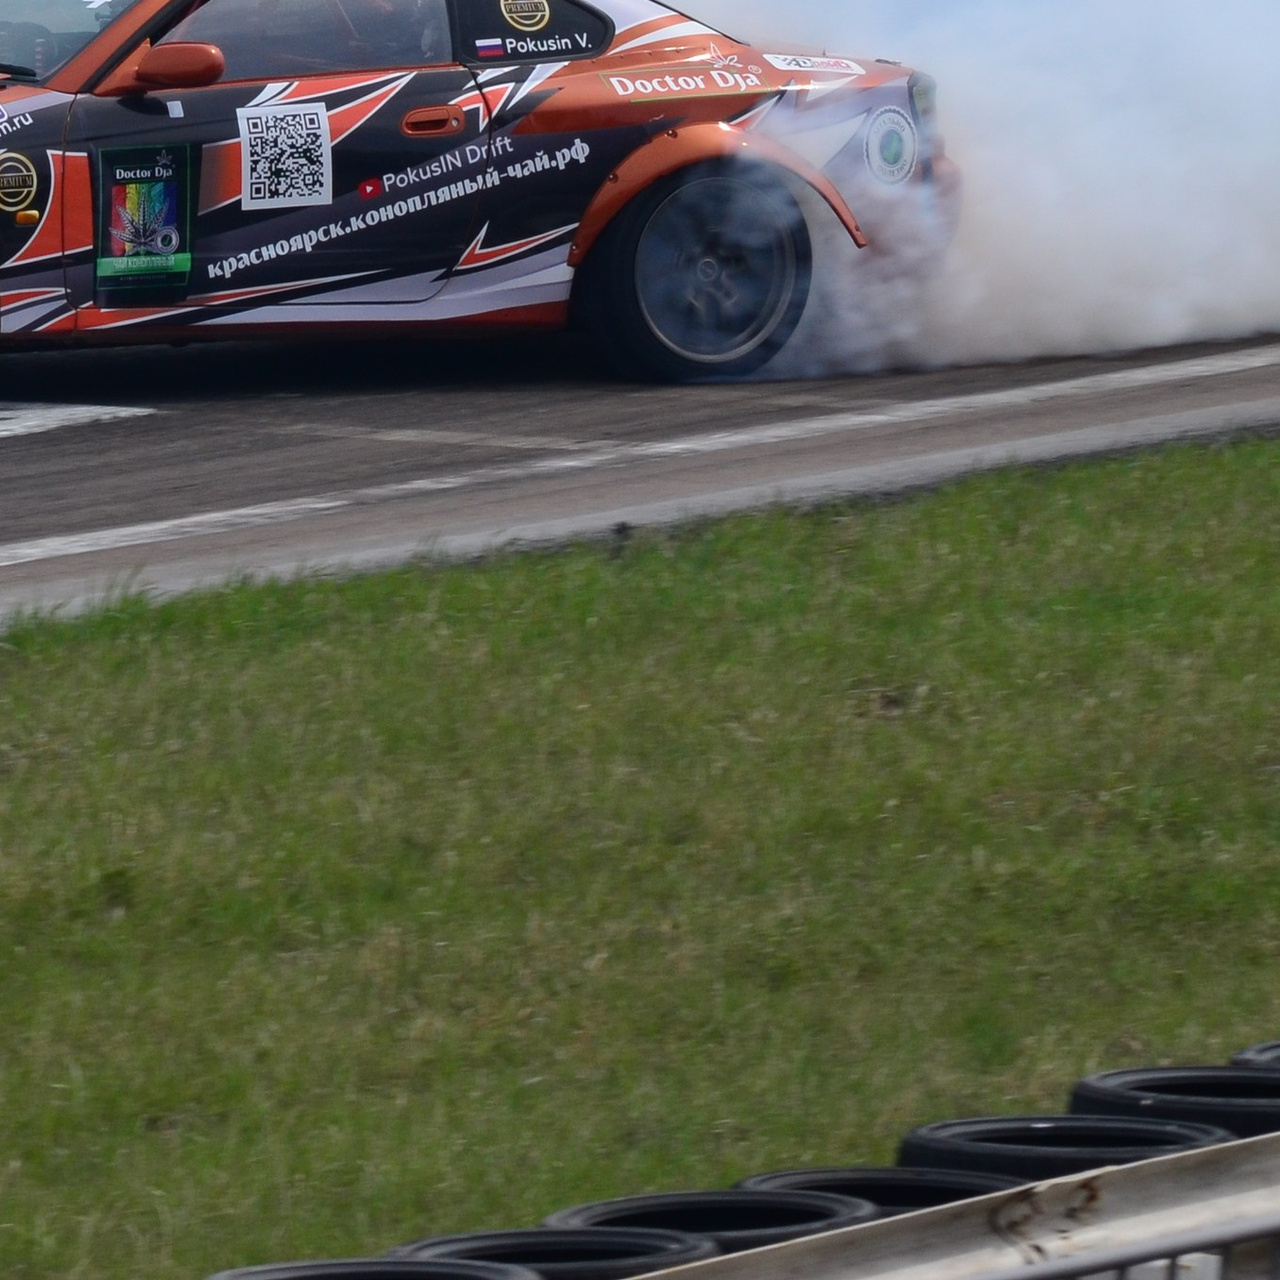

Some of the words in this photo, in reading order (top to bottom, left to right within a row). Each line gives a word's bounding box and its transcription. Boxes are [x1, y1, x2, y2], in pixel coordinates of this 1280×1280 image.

[505, 1, 546, 13] PREMIUM
[506, 36, 571, 53] Pokusin
[574, 32, 592, 48] V.
[609, 74, 705, 96] Doctor
[116, 168, 151, 179] Doctor
[155, 166, 173, 178] Dja
[382, 145, 463, 193] PokusIN
[465, 136, 514, 165] Drift
[207, 138, 590, 279] красноярск.конопляный-чай.рф
